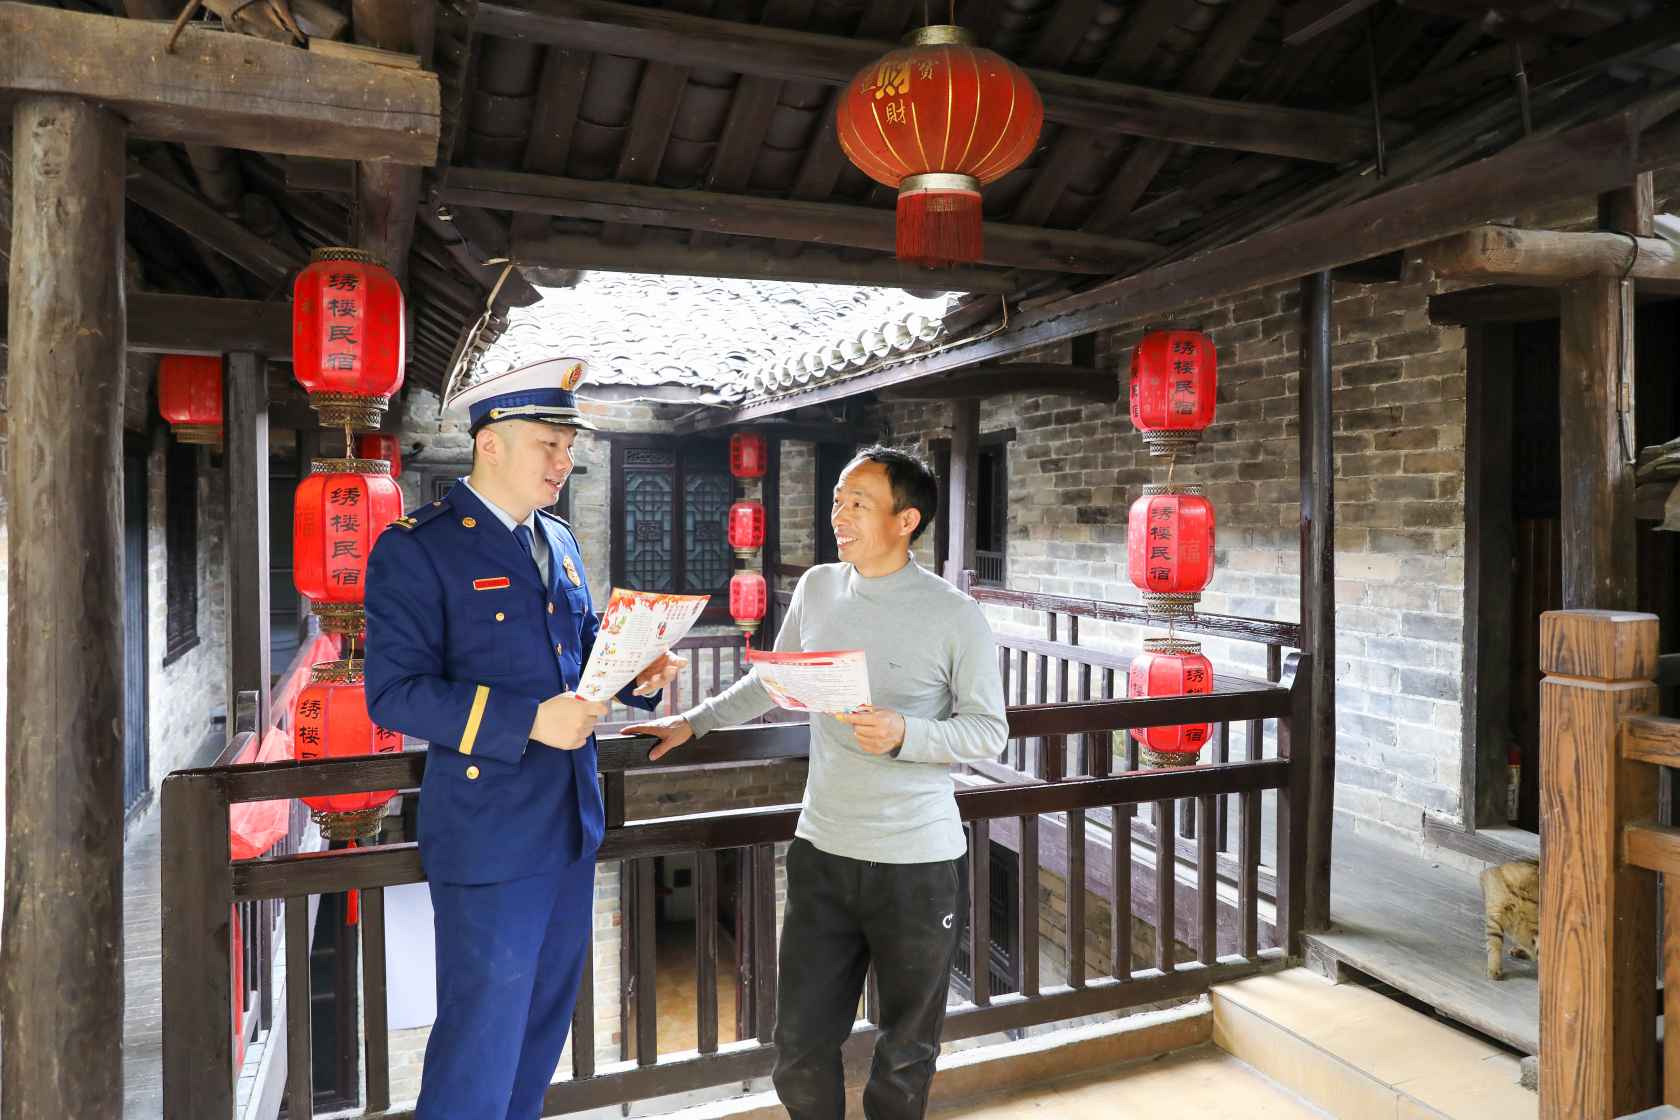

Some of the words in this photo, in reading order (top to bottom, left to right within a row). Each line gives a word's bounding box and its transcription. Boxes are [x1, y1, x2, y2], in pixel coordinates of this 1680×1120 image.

[328, 273, 359, 372] 绣楼民宿
[1173, 341, 1196, 415] 绣楼民宿
[330, 486, 362, 585] 绣楼民宿
[1150, 506, 1174, 581] 绣楼民宿
